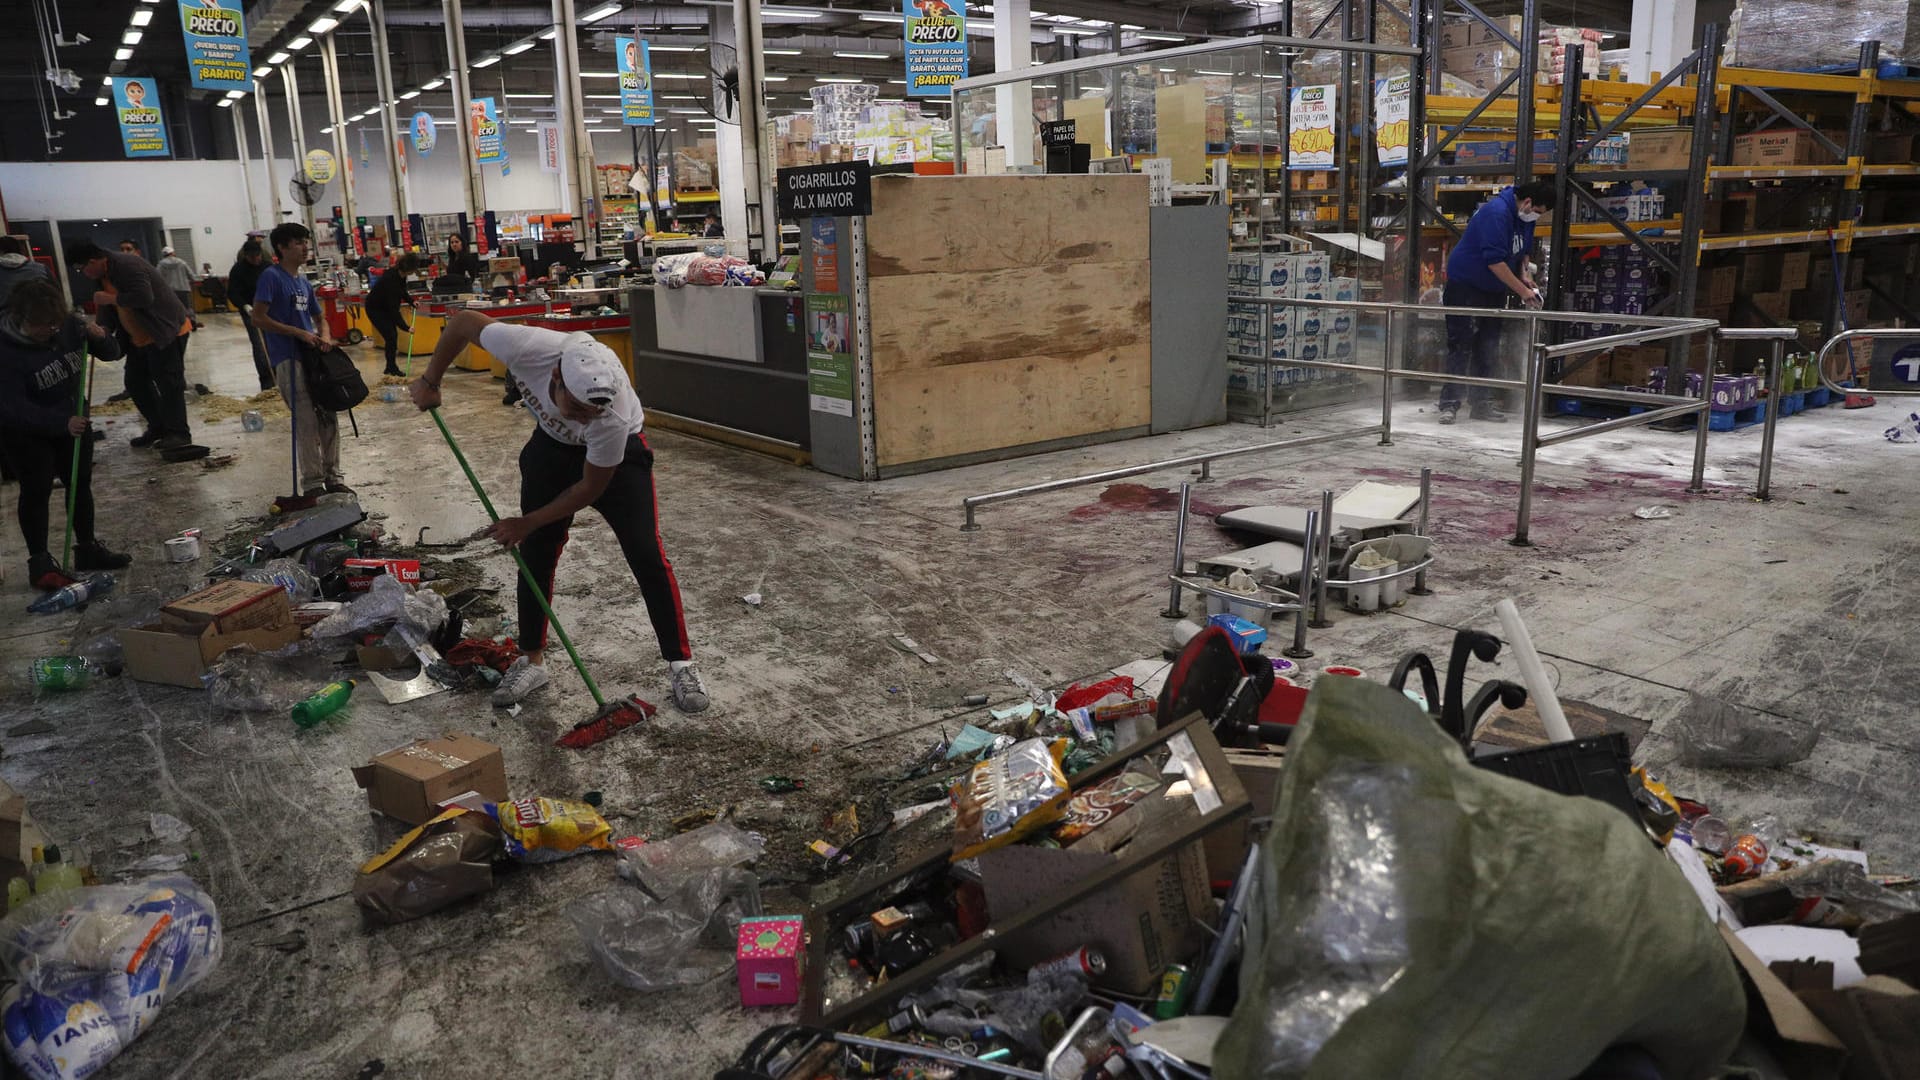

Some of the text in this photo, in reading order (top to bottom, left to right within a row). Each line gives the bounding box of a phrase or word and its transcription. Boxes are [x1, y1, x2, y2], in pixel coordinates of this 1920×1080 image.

[198, 8, 221, 18] CLUB
[190, 16, 236, 34] PRECIO
[921, 16, 945, 26] CLUB
[912, 25, 958, 40] PRECIO
[200, 68, 245, 80] ¡BARATO!
[125, 114, 156, 123] PRECIO
[1068, 124, 1074, 132] DE
[1054, 133, 1075, 141] TABACO
[789, 170, 856, 190] CIGARRILLOS
[793, 192, 854, 209] AL X MAYOR
[53, 1014, 113, 1048] IANS
